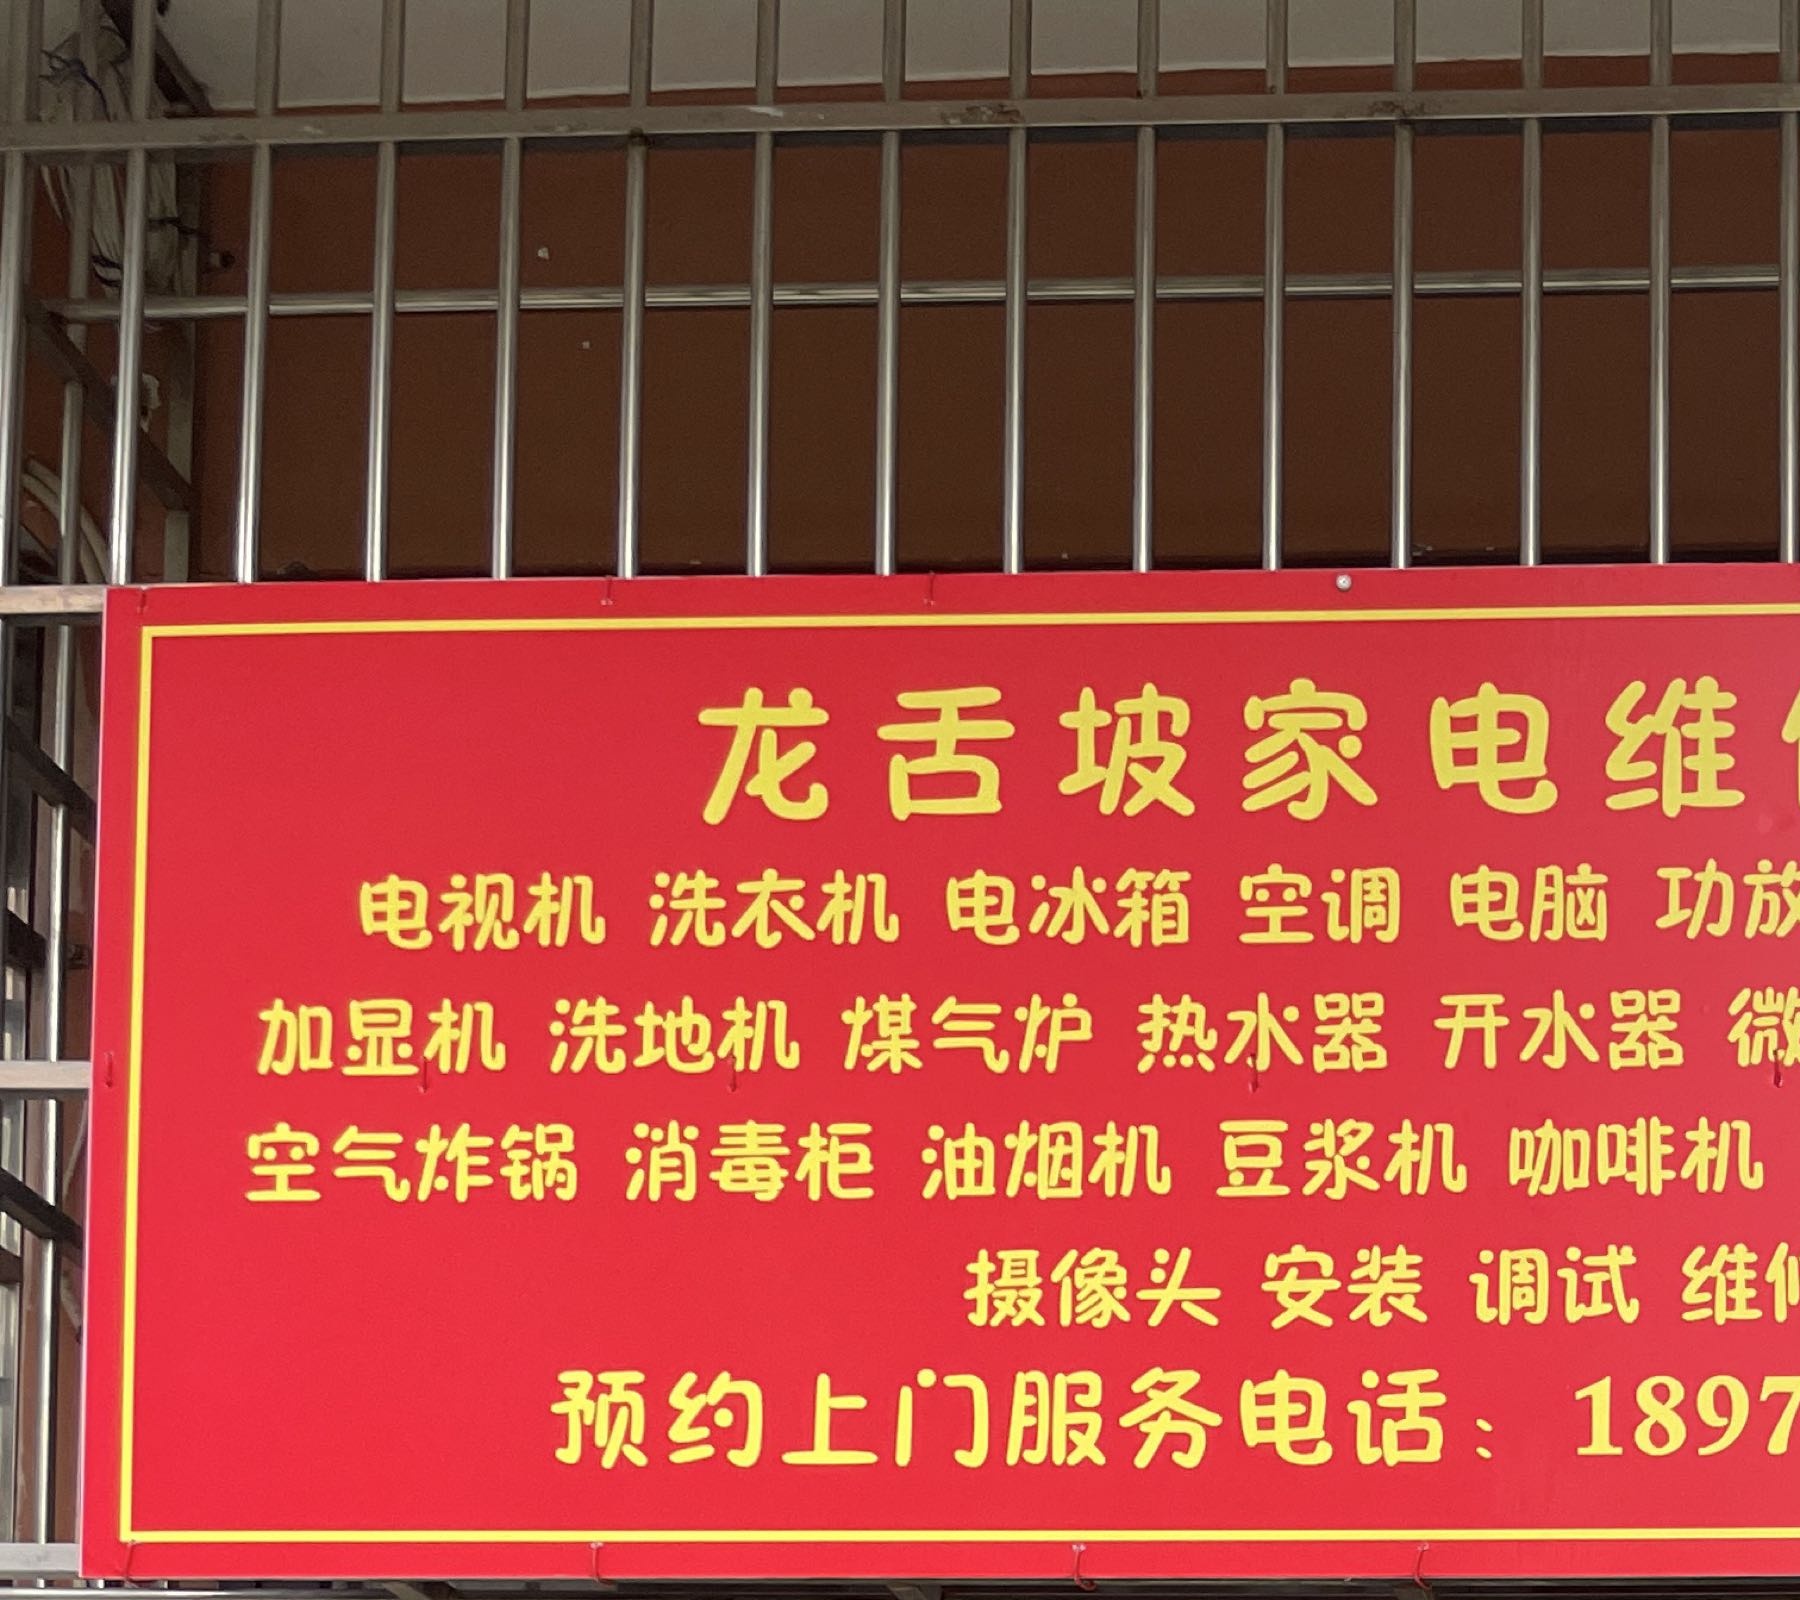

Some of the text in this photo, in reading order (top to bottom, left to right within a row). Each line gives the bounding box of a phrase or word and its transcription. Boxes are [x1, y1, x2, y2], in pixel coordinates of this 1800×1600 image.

[361, 874, 603, 949] 电视机
[651, 870, 898, 947] 洗衣机
[948, 868, 1188, 945] 电冰箱
[1242, 866, 1399, 941] 空调
[1452, 865, 1605, 939] 电脑
[258, 998, 506, 1076] 加显机
[549, 996, 801, 1074] 洗地机
[841, 993, 1093, 1074] 煤气炉
[1137, 992, 1388, 1073] 热水器
[1434, 989, 1684, 1070] 开水器
[246, 1122, 578, 1203] 空气炸锅
[625, 1120, 874, 1202] 消毒柜
[921, 1120, 1172, 1201] 油烟机
[1216, 1118, 1467, 1200] 豆浆机
[1508, 1116, 1764, 1196] 咖啡机
[963, 1246, 1221, 1329] 摄像头
[1261, 1244, 1428, 1329] 安装
[1469, 1245, 1640, 1326] 调试
